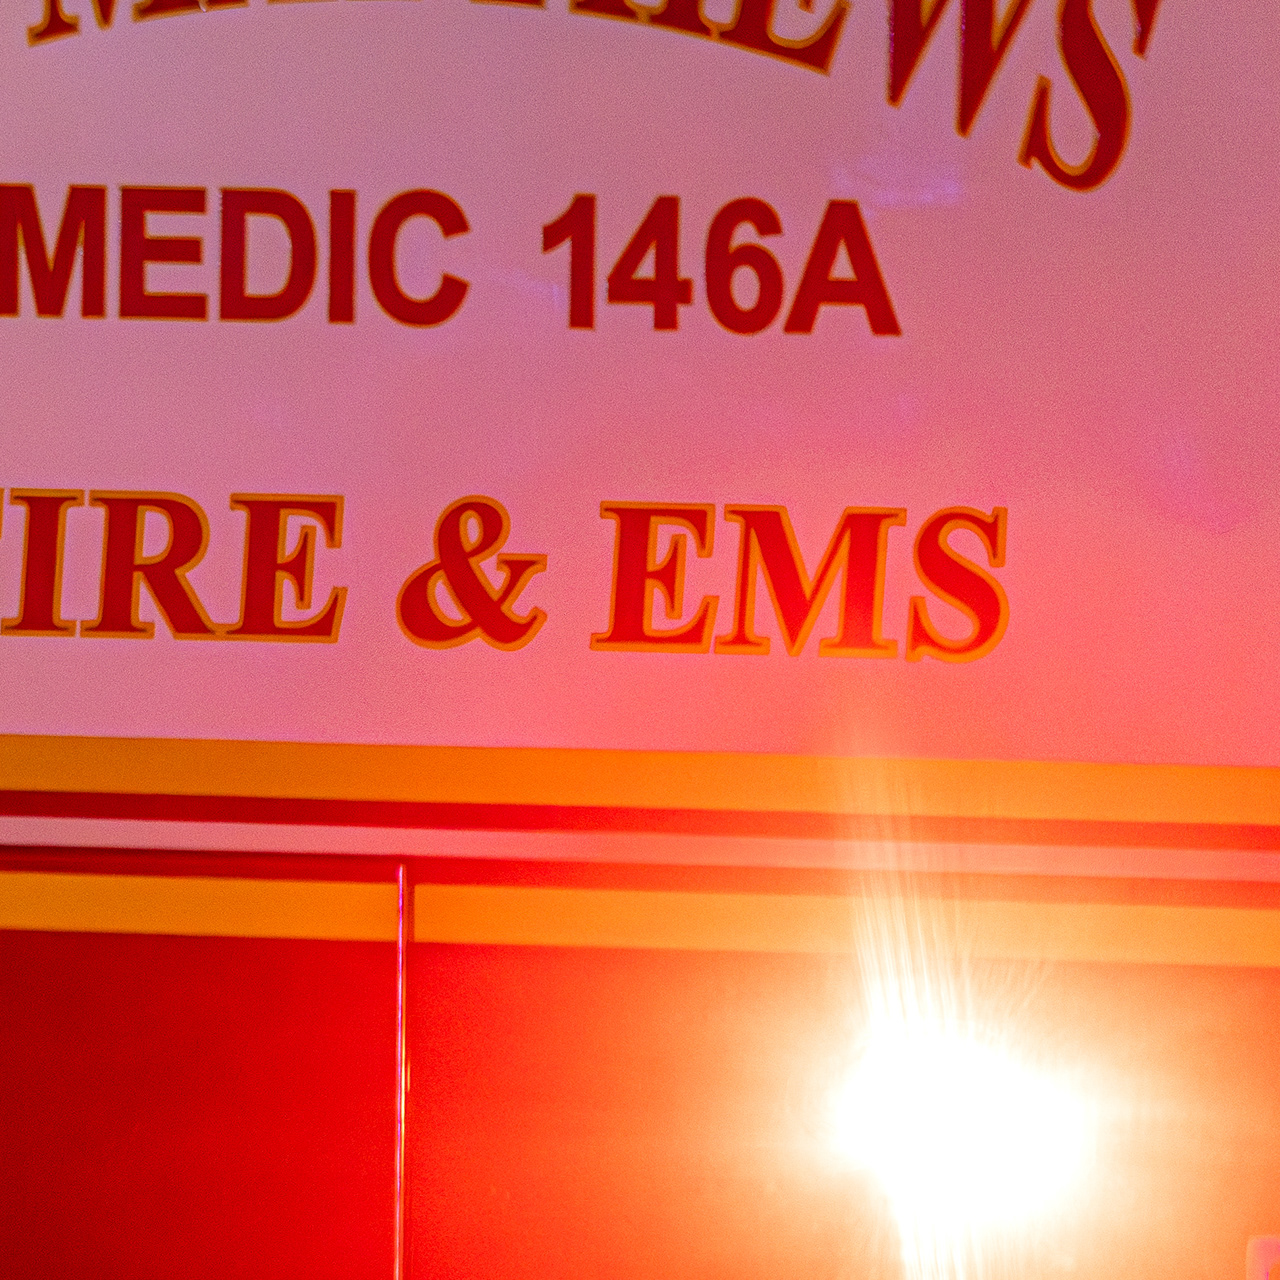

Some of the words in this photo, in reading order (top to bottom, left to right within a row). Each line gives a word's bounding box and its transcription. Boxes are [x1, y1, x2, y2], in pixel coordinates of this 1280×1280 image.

[541, 195, 903, 337] 146A
[396, 495, 548, 651] &
[589, 500, 1009, 663] EMS
